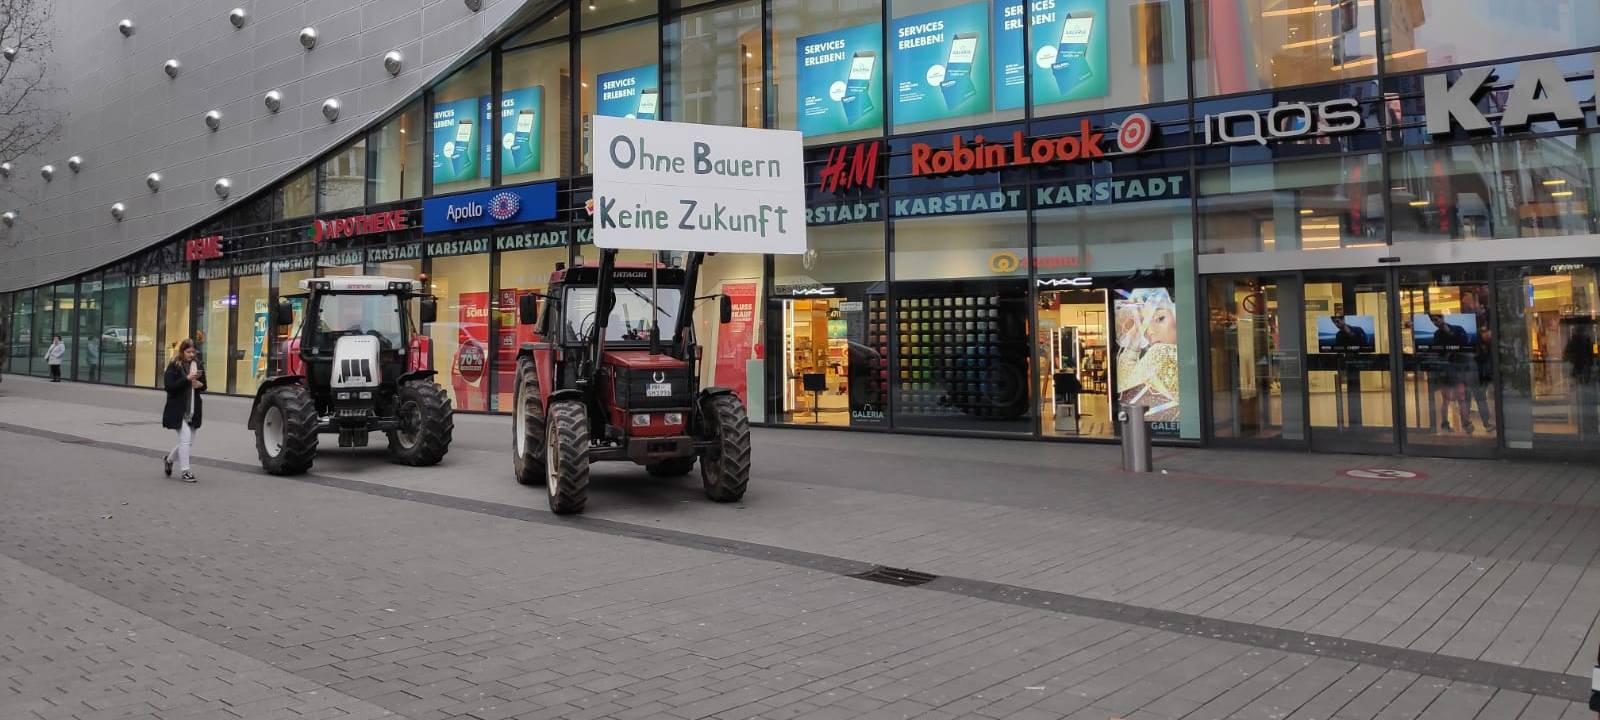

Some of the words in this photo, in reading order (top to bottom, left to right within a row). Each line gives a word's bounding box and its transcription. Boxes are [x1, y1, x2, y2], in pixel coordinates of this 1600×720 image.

[1004, 0, 1056, 17] SERICES
[899, 20, 944, 38] SERVICES
[1004, 12, 1056, 31] ERLBEN!
[804, 39, 846, 55] SERVICES
[899, 33, 944, 50] ERLEBEN!
[804, 51, 846, 67] ERLEBEN!
[603, 77, 636, 90] SERVICES
[603, 88, 636, 101] ERLEBEN!
[1422, 53, 1600, 134] KA
[1204, 97, 1362, 146] IQOS
[609, 135, 685, 174] Ohne
[693, 141, 781, 178] Bauern
[911, 134, 1005, 177] Robin
[1013, 119, 1106, 165] Look
[819, 141, 880, 194] H&M
[1036, 175, 1184, 206] KARSTADT
[447, 203, 483, 223] Apollo
[895, 190, 1022, 217] KARSTADT
[599, 195, 669, 230] Keine
[678, 199, 789, 238] Zukunft
[806, 202, 880, 225] RSTADT
[326, 209, 408, 239] APOTHEKE
[427, 238, 489, 257] KARSTADT
[496, 231, 567, 250] KARSTADT
[317, 250, 363, 268] KARSTADT
[367, 242, 420, 262] KARSTADT
[792, 287, 835, 296] MAC
[1036, 277, 1093, 287] MAC
[460, 353, 483, 366] 70%
[852, 410, 884, 418] GALERIA
